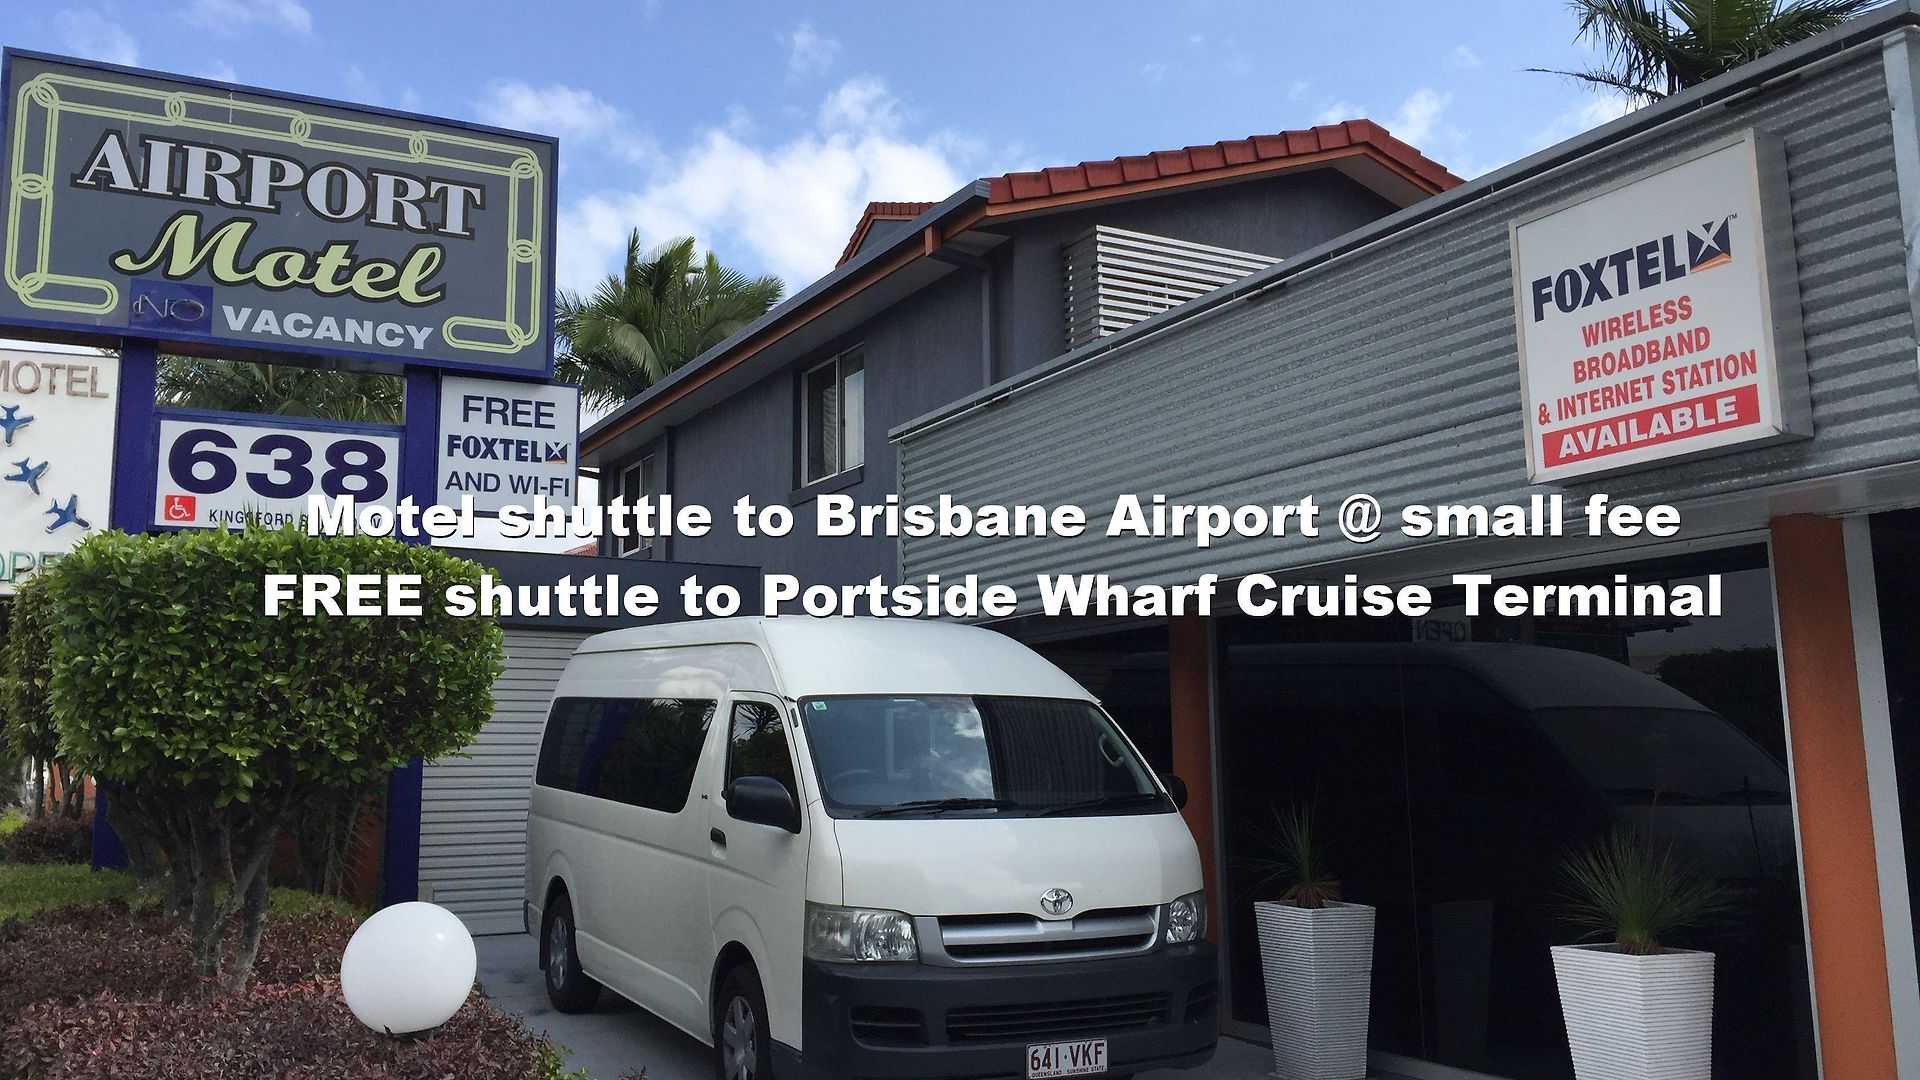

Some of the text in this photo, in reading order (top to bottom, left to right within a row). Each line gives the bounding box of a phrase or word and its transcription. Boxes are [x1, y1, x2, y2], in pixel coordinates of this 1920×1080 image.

[71, 129, 486, 238] AIRPORT
[110, 210, 446, 306] Motel
[1531, 234, 1688, 323] FOXTEL
[221, 305, 434, 351] VACANCY
[1582, 295, 1693, 349] WIRELESS
[1573, 326, 1711, 384] BROADBAND
[462, 394, 556, 430] FREE
[1538, 349, 1758, 426] & INTERNET STATION
[447, 434, 542, 463] FOXTEL
[1558, 395, 1739, 459] AVAILABLE
[168, 428, 389, 503] 638
[445, 470, 570, 497] AND WI-FI
